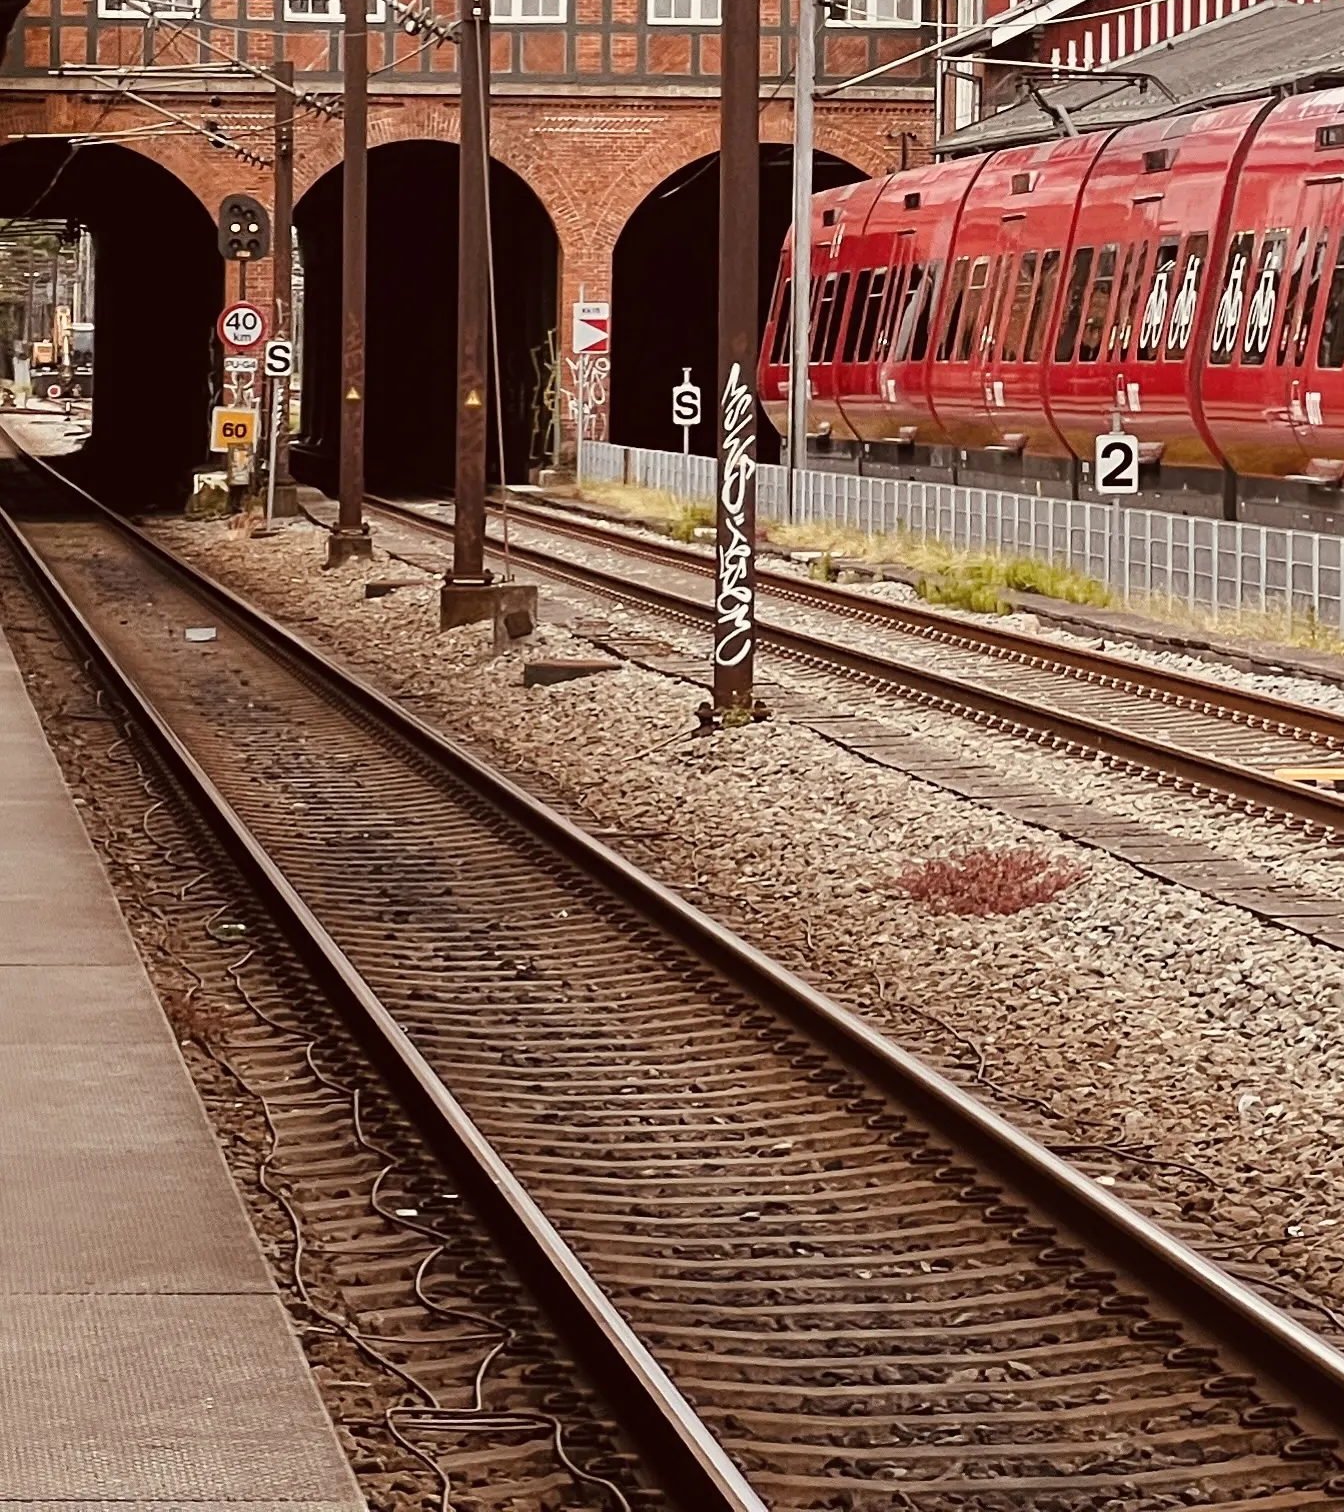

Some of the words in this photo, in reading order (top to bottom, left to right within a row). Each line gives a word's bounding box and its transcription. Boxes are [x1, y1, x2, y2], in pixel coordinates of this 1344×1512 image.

[226, 312, 257, 331] 40
[233, 333, 251, 342] km
[266, 344, 290, 373] S
[674, 390, 699, 420] S
[222, 422, 247, 438] 60
[1101, 441, 1134, 487] 2
